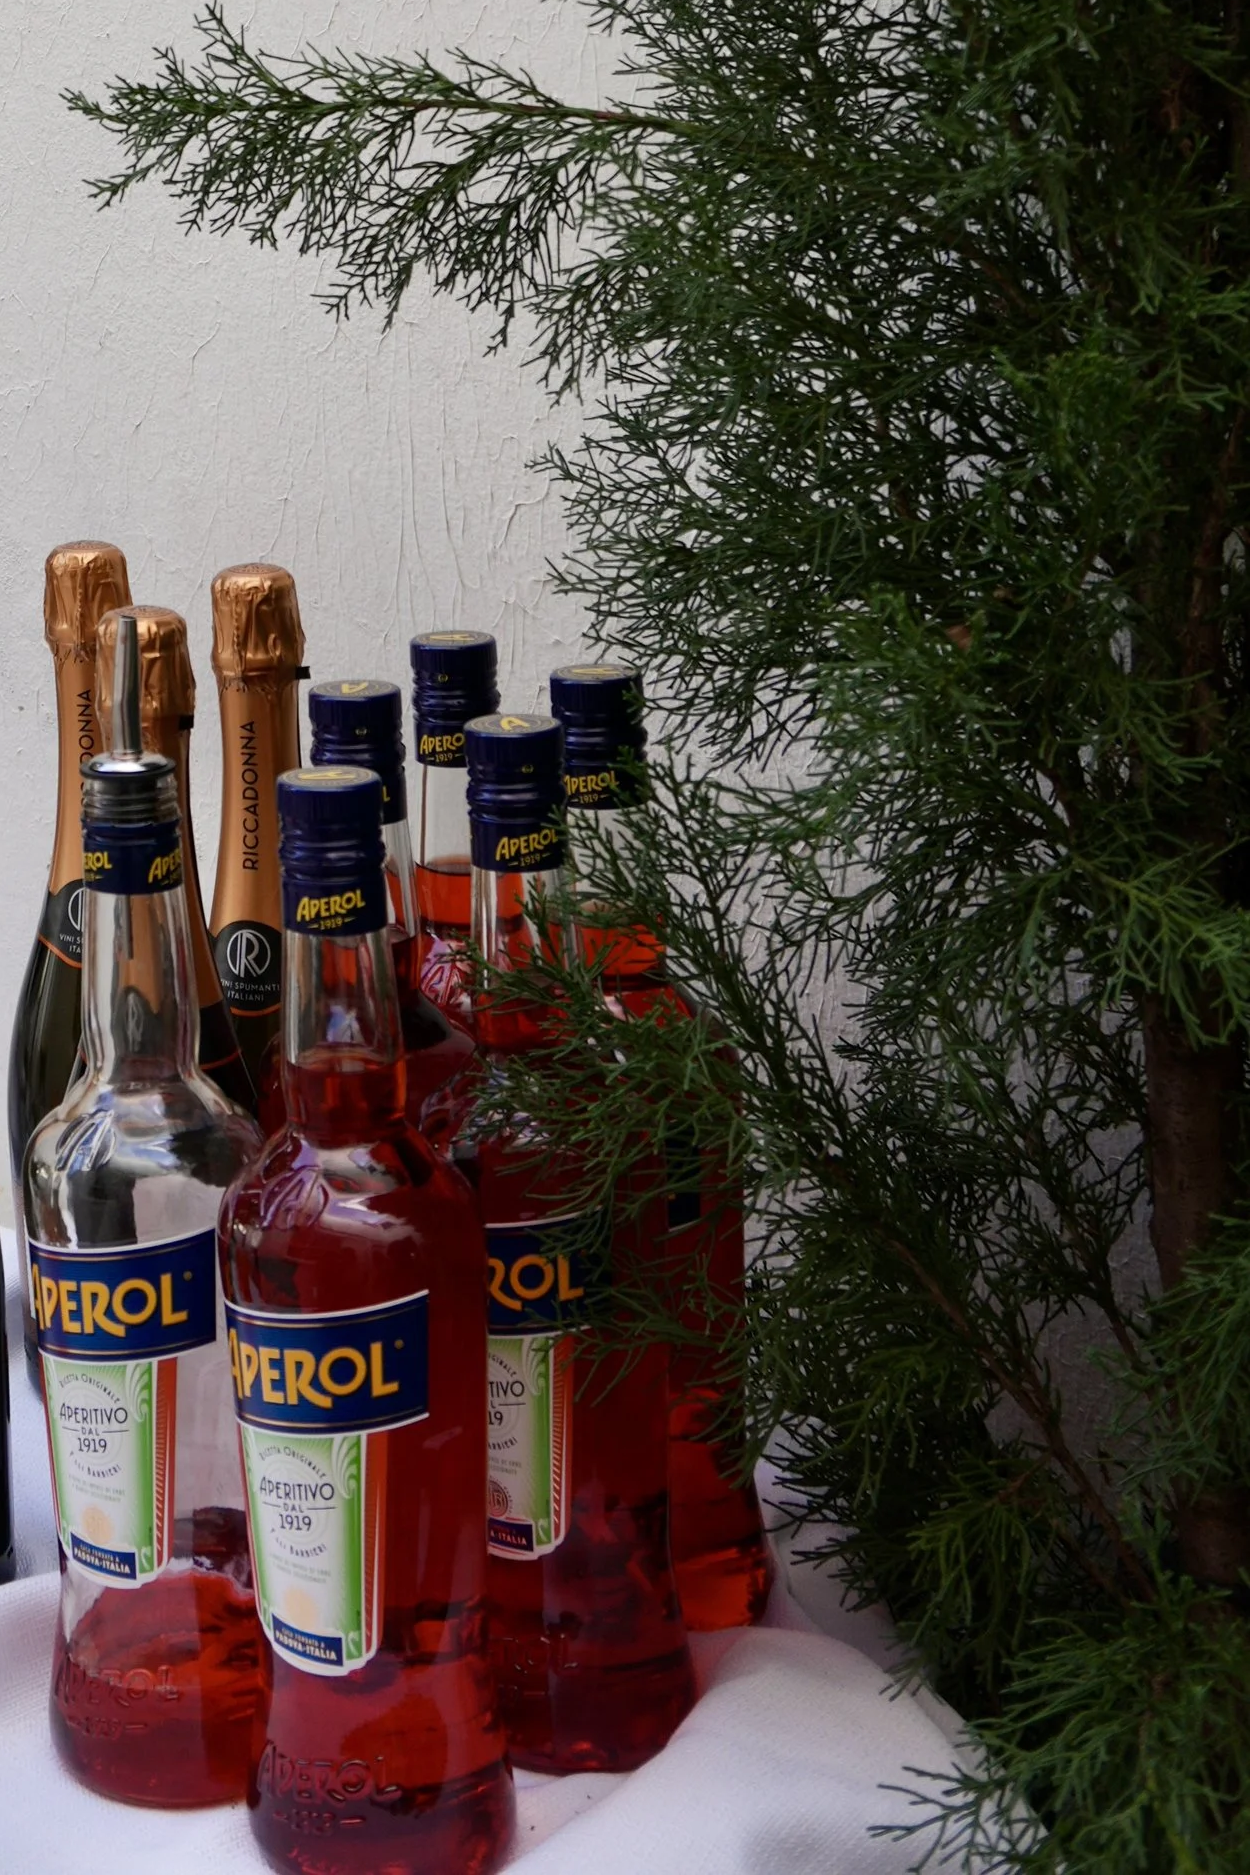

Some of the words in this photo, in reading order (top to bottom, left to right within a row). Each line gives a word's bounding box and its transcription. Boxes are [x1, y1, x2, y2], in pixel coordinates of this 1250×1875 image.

[240, 720, 259, 871] RICCADONNA
[495, 829, 558, 862] APEROL
[519, 853, 541, 867] 1919
[296, 887, 366, 922] APEROL
[319, 918, 343, 930] 1919
[227, 990, 264, 1002] ITALIANI
[234, 981, 280, 992] SPUMANTI
[32, 1261, 189, 1338] APEROL
[228, 1326, 400, 1409] APEROL
[59, 1402, 128, 1425] APERITIVO
[81, 1426, 100, 1437] DAL
[77, 1437, 108, 1454] 1919
[259, 1474, 335, 1502] APERITIVO
[282, 1502, 304, 1513] DAL
[279, 1513, 312, 1532] 1919
[256, 1739, 403, 1809] APEROL
